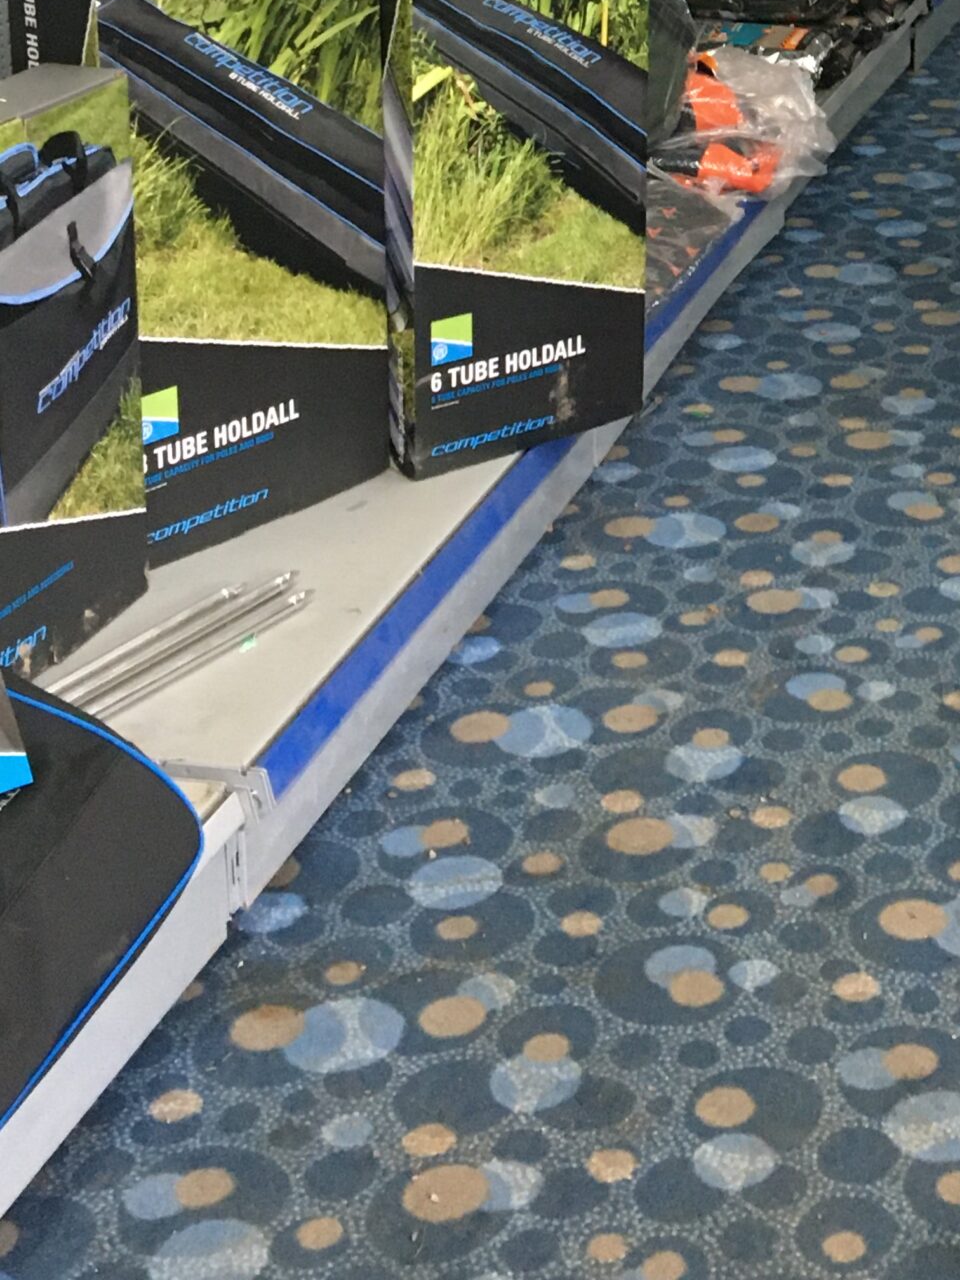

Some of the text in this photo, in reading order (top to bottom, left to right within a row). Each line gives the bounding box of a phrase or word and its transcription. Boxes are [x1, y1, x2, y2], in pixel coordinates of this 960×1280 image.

[184, 31, 314, 115] competition
[37, 297, 131, 414] competition
[430, 334, 587, 393] 6 TUBE HOLDALL
[154, 430, 209, 470] TUBE
[213, 398, 300, 449] HOLDALL
[431, 415, 555, 457] competition
